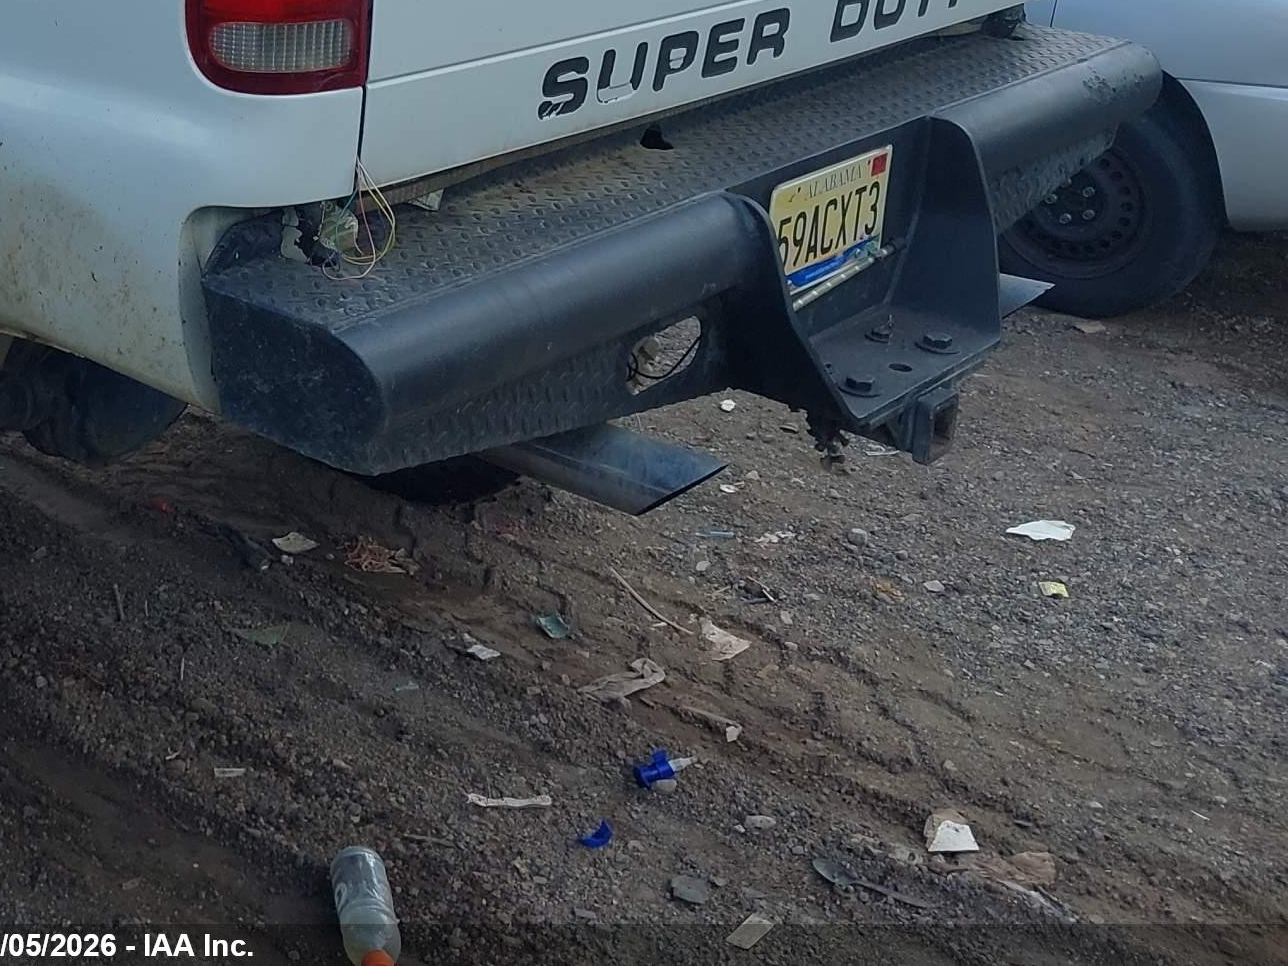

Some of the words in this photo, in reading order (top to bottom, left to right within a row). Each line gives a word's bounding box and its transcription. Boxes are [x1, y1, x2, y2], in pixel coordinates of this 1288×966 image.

[537, 7, 791, 121] SUPER
[777, 181, 881, 269] 59ACXT3
[807, 164, 862, 199] ALABAMA
